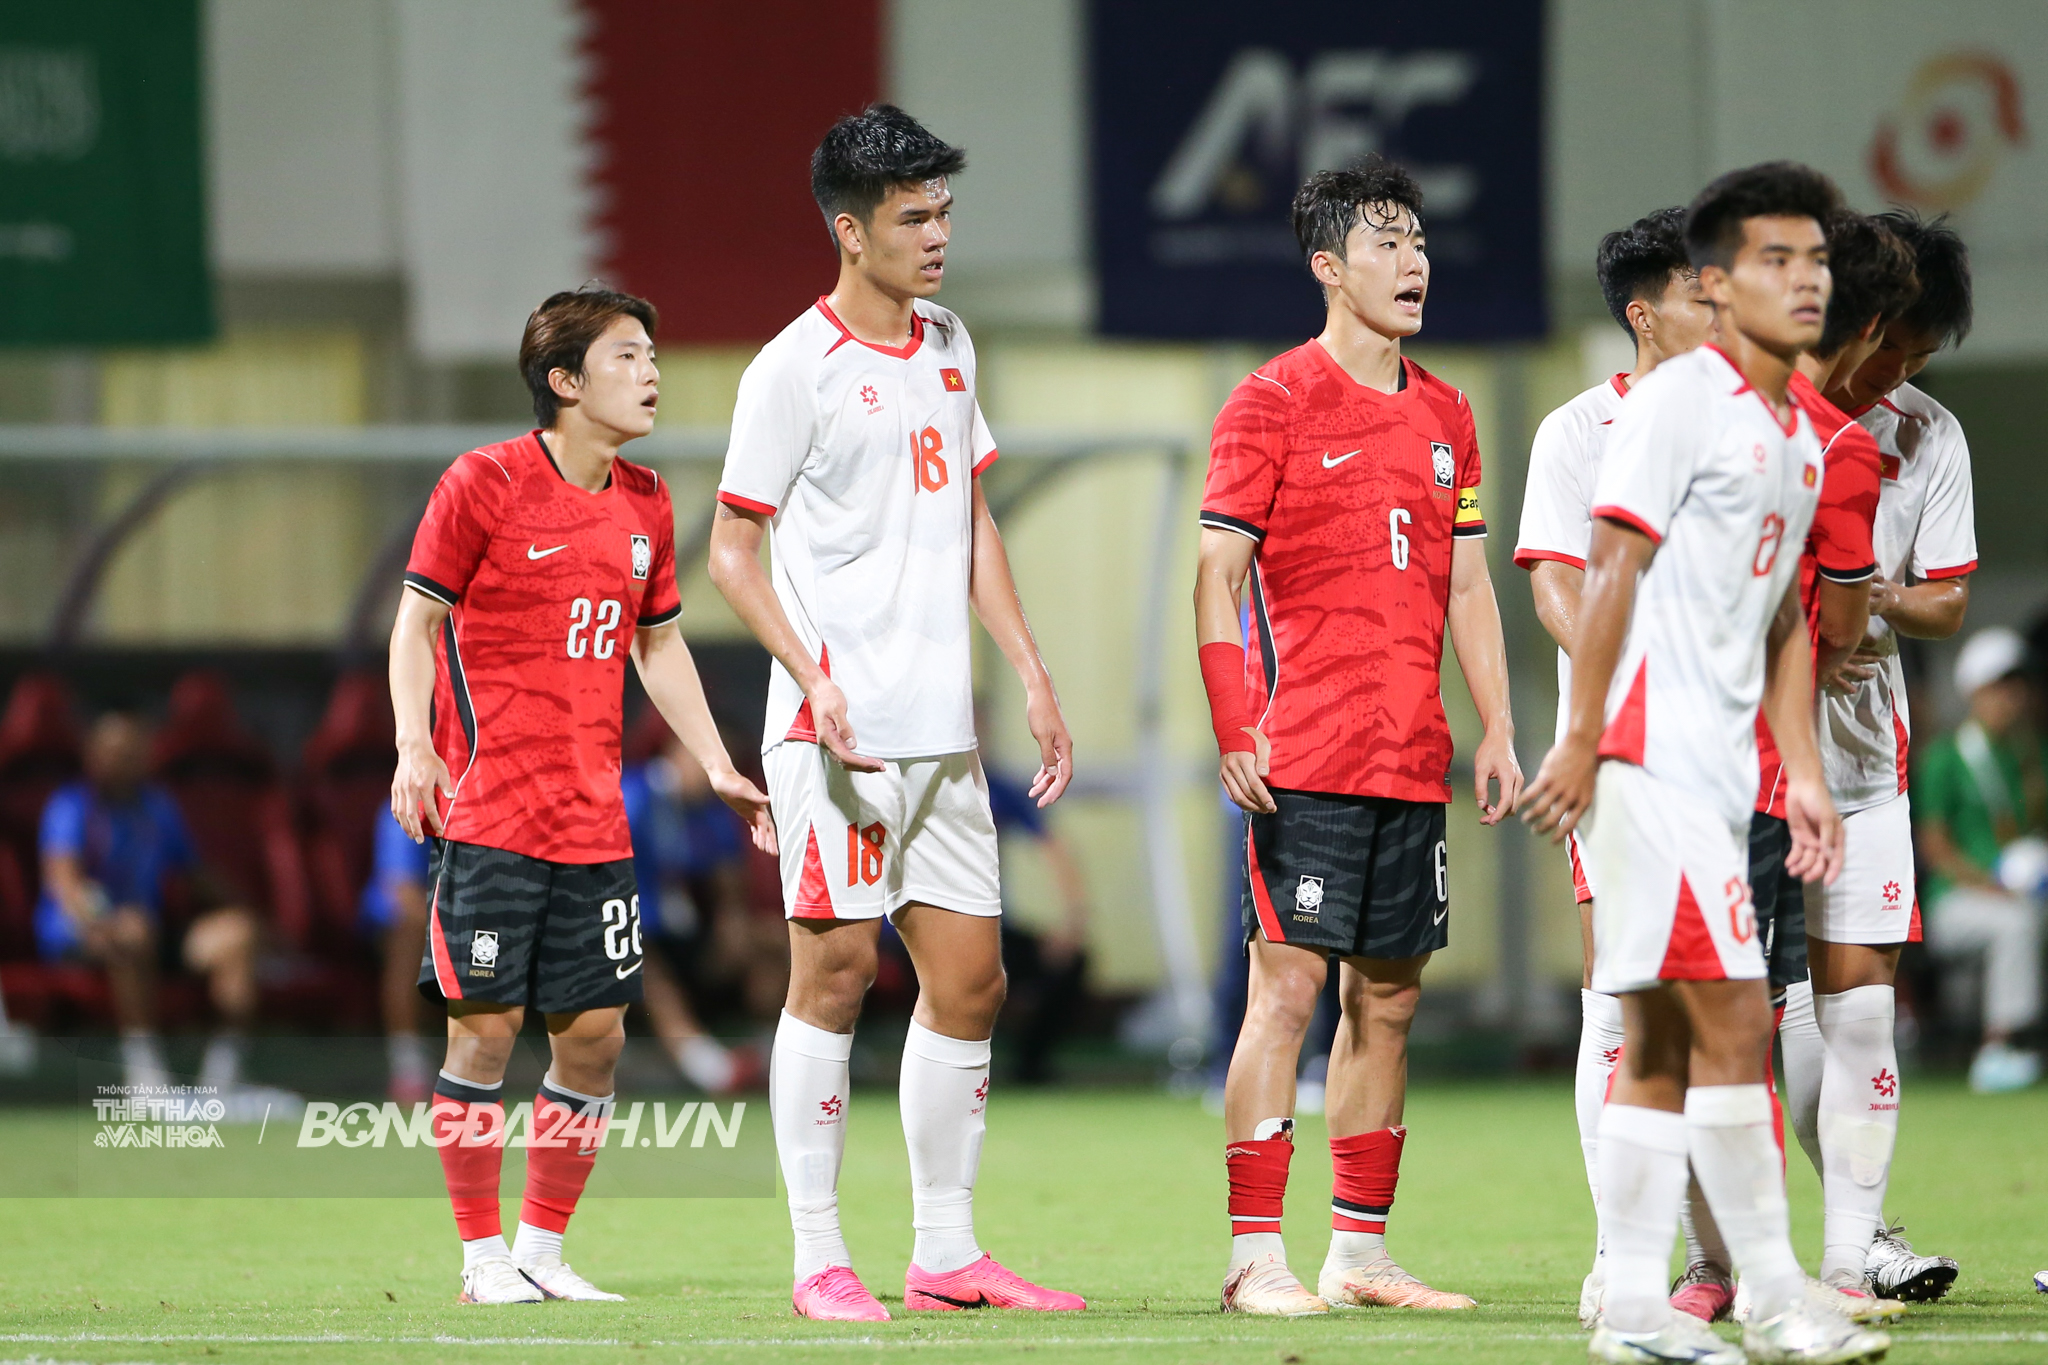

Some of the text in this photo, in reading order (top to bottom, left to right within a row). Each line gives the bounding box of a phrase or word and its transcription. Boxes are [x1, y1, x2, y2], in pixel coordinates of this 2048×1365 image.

[910, 425, 949, 496] 18
[1389, 508, 1412, 571] 6
[566, 597, 622, 660] 22
[847, 820, 886, 888] 18
[1434, 840, 1448, 902] 6
[1292, 913, 1320, 924] KOREA
[469, 969, 495, 978] KOREA
